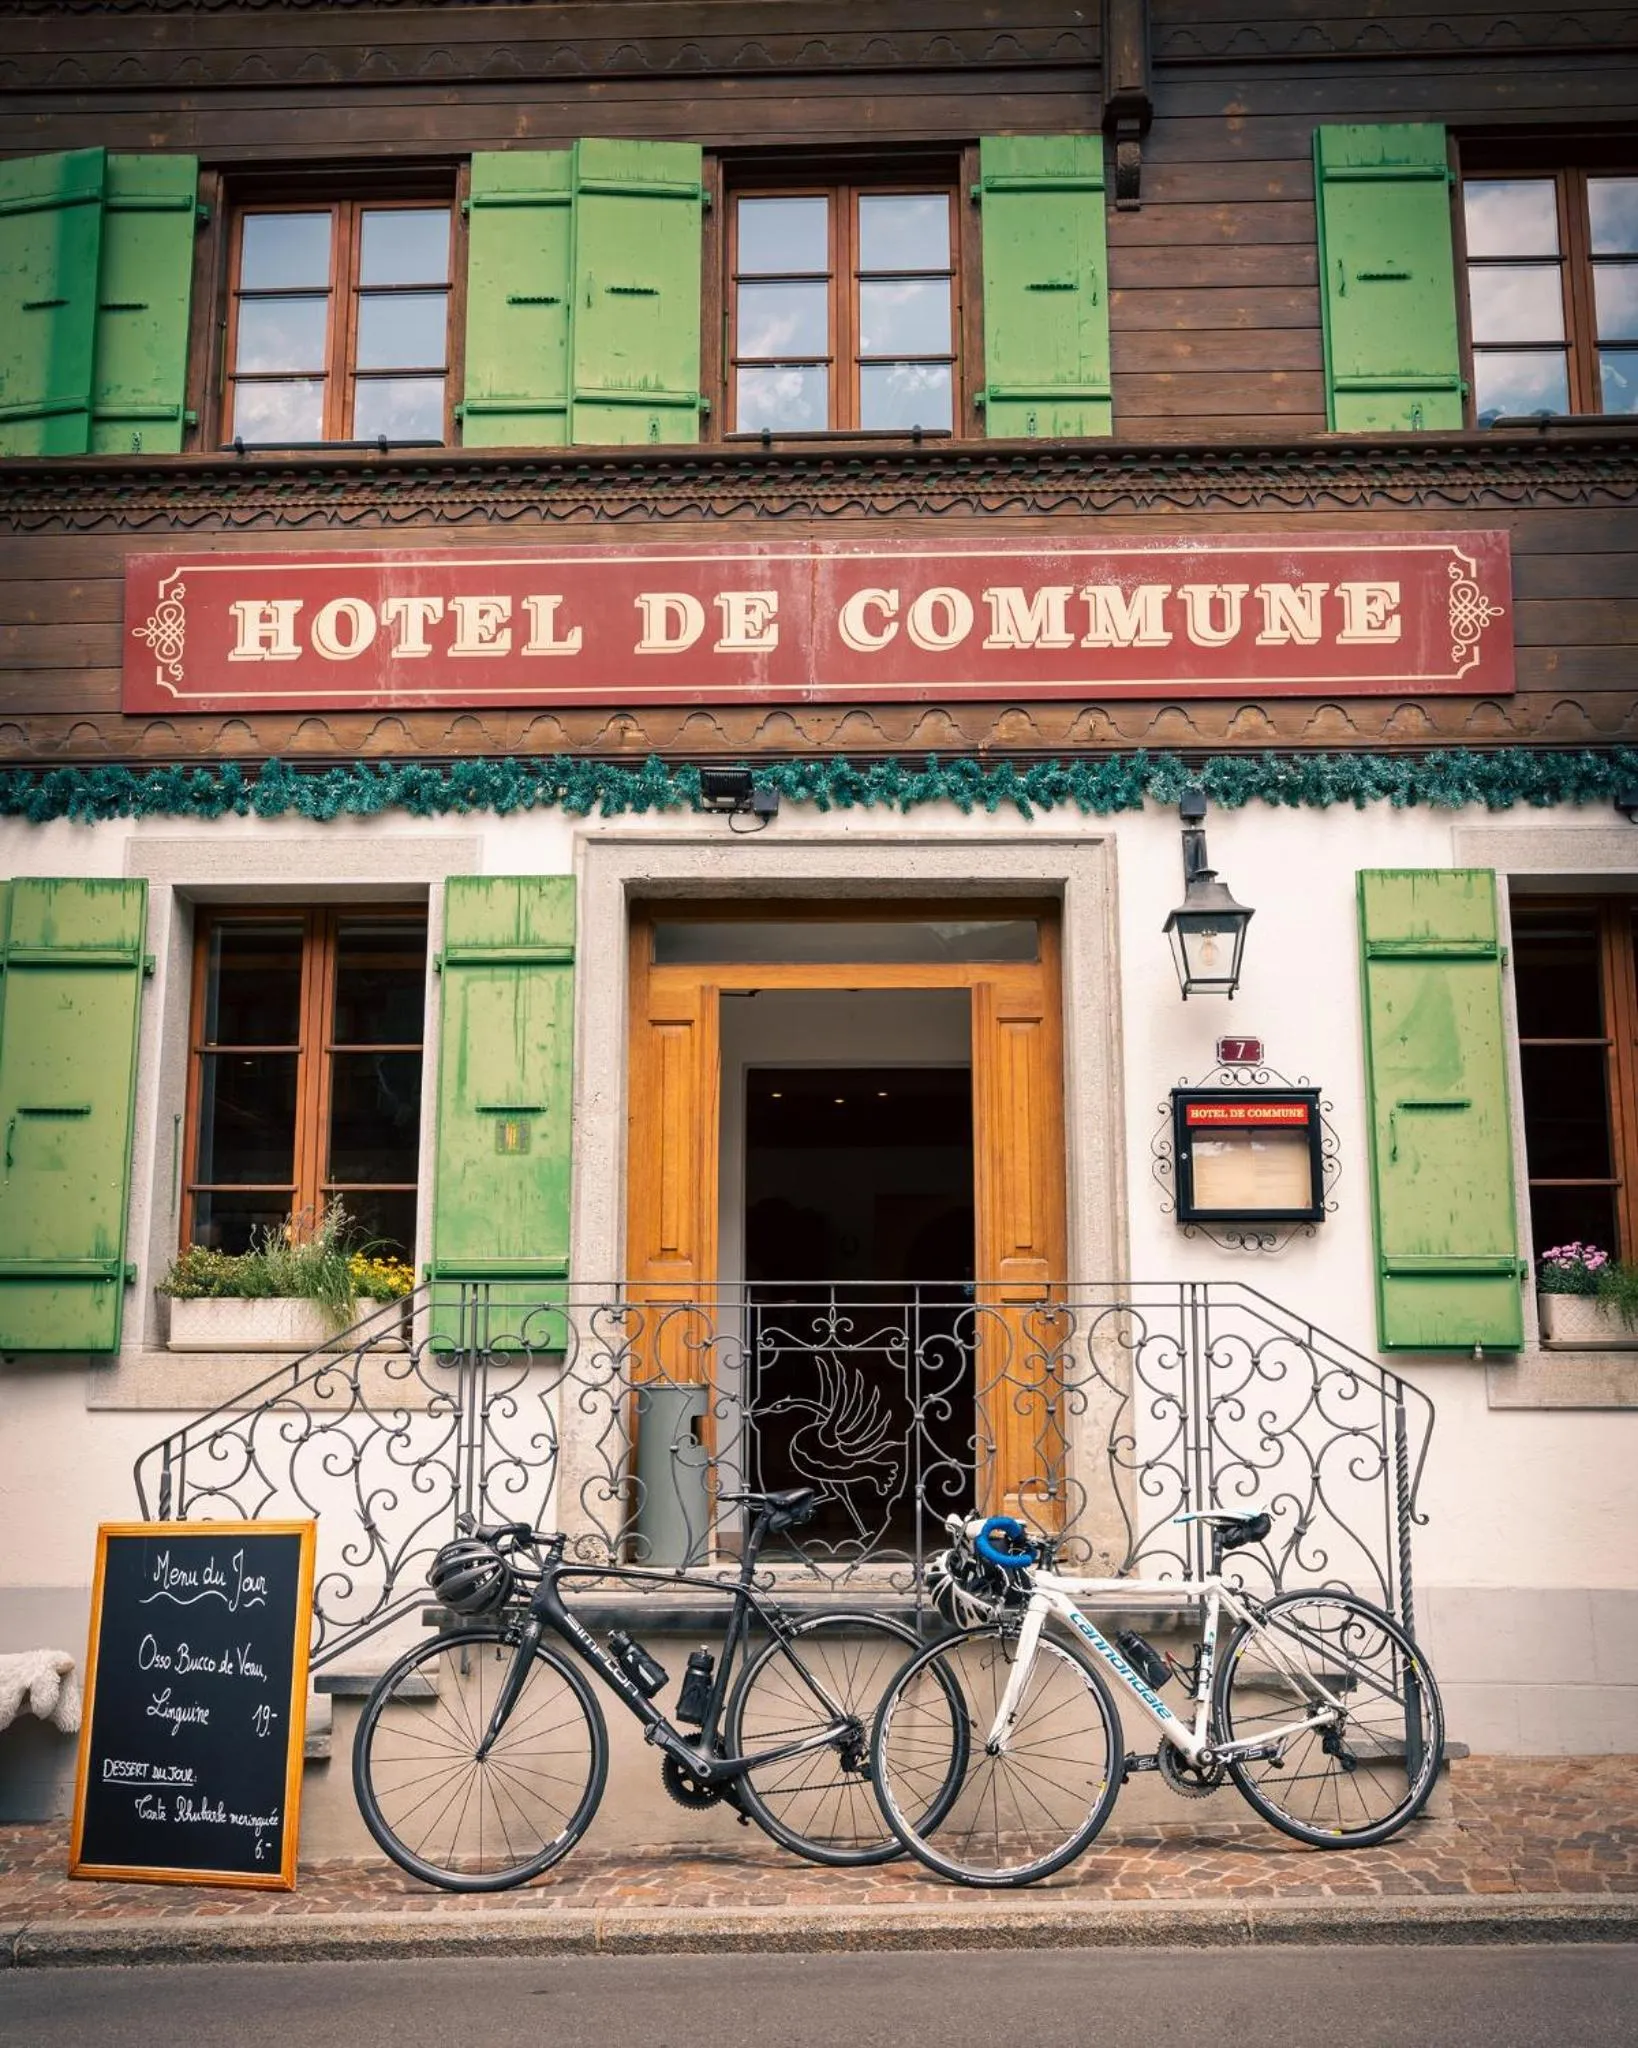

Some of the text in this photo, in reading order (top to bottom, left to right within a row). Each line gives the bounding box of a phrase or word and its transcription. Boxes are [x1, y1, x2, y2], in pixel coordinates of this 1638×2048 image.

[228, 580, 1402, 662] HOTEL DE COMMUNE
[1235, 1042, 1246, 1060] 7
[1190, 1107, 1305, 1119] HOTEL DE COMMUNE
[153, 1548, 268, 1612] Menu du Jour
[138, 1633, 172, 1671] Osso
[174, 1642, 216, 1675] Bucco
[217, 1649, 234, 1675] de
[563, 1612, 641, 1698] SIMPLON
[1068, 1612, 1173, 1720] cannondale
[146, 1687, 210, 1737] Linguine
[102, 1758, 150, 1779] DESSERT
[134, 1794, 280, 1838] Tarte Rhubarbe meringuée
